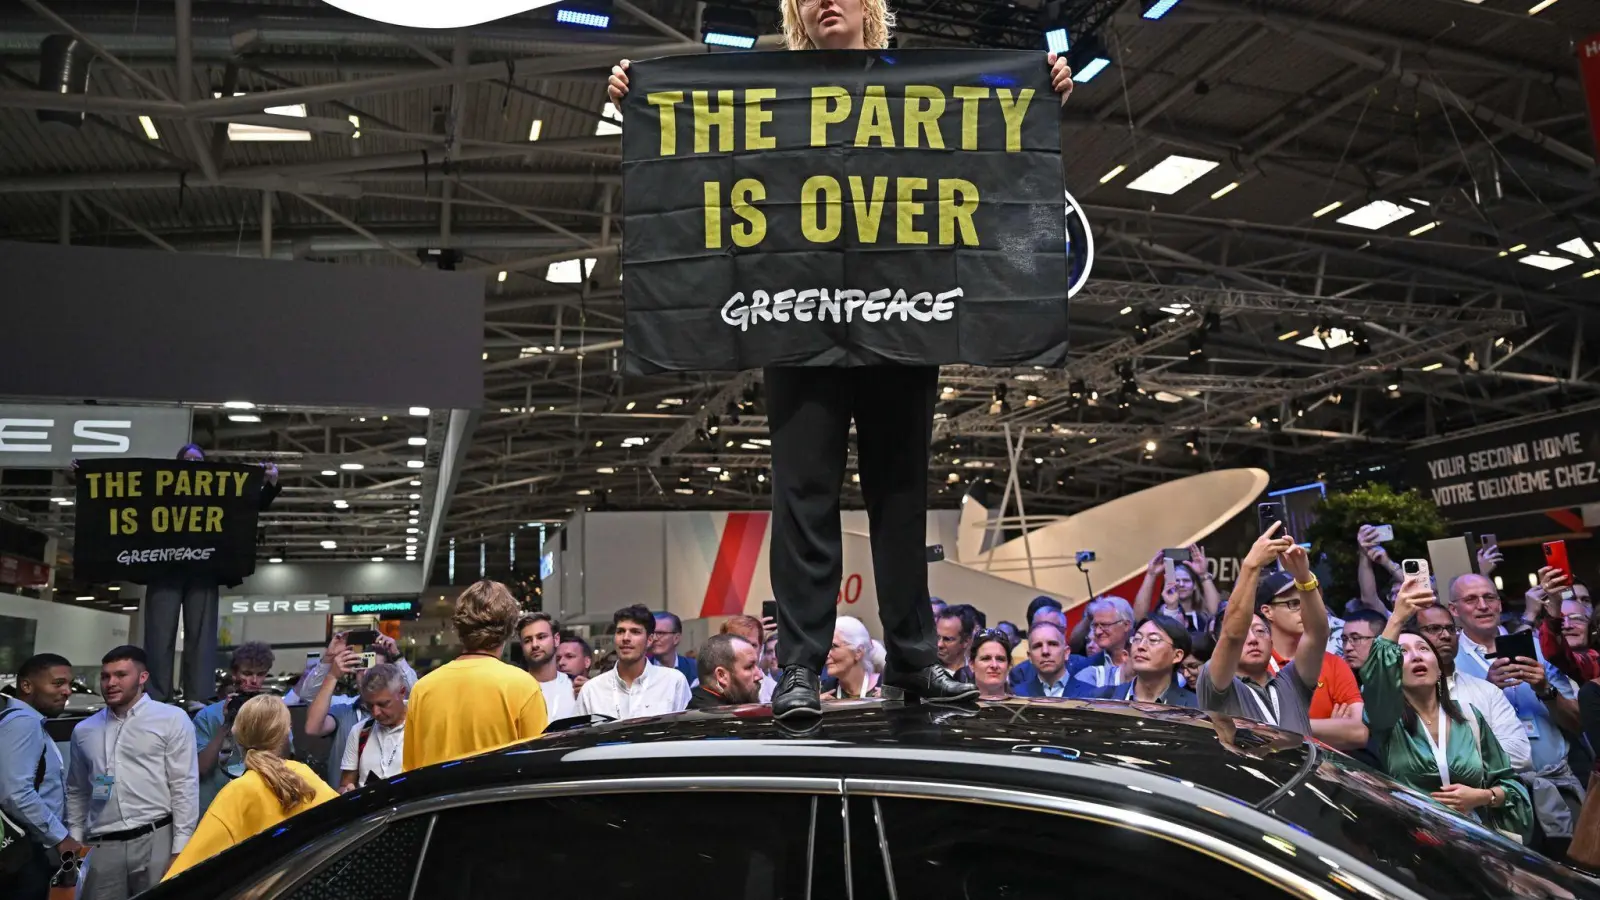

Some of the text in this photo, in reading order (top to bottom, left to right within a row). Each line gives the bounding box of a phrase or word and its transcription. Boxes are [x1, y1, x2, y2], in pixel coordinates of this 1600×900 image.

[647, 85, 1035, 156] THE PARTY
[704, 175, 980, 249] IS OVER
[720, 287, 964, 332] GREENPEACE
[1428, 432, 1583, 480] YOUR SECOND HOME
[85, 470, 249, 499] THE PARTY
[1431, 482, 1476, 507] VOTRE
[1479, 471, 1553, 500] DEUXIÈME
[109, 506, 224, 535] IS OVER
[117, 547, 215, 565] GREENPEACE
[232, 600, 330, 613] SERES
